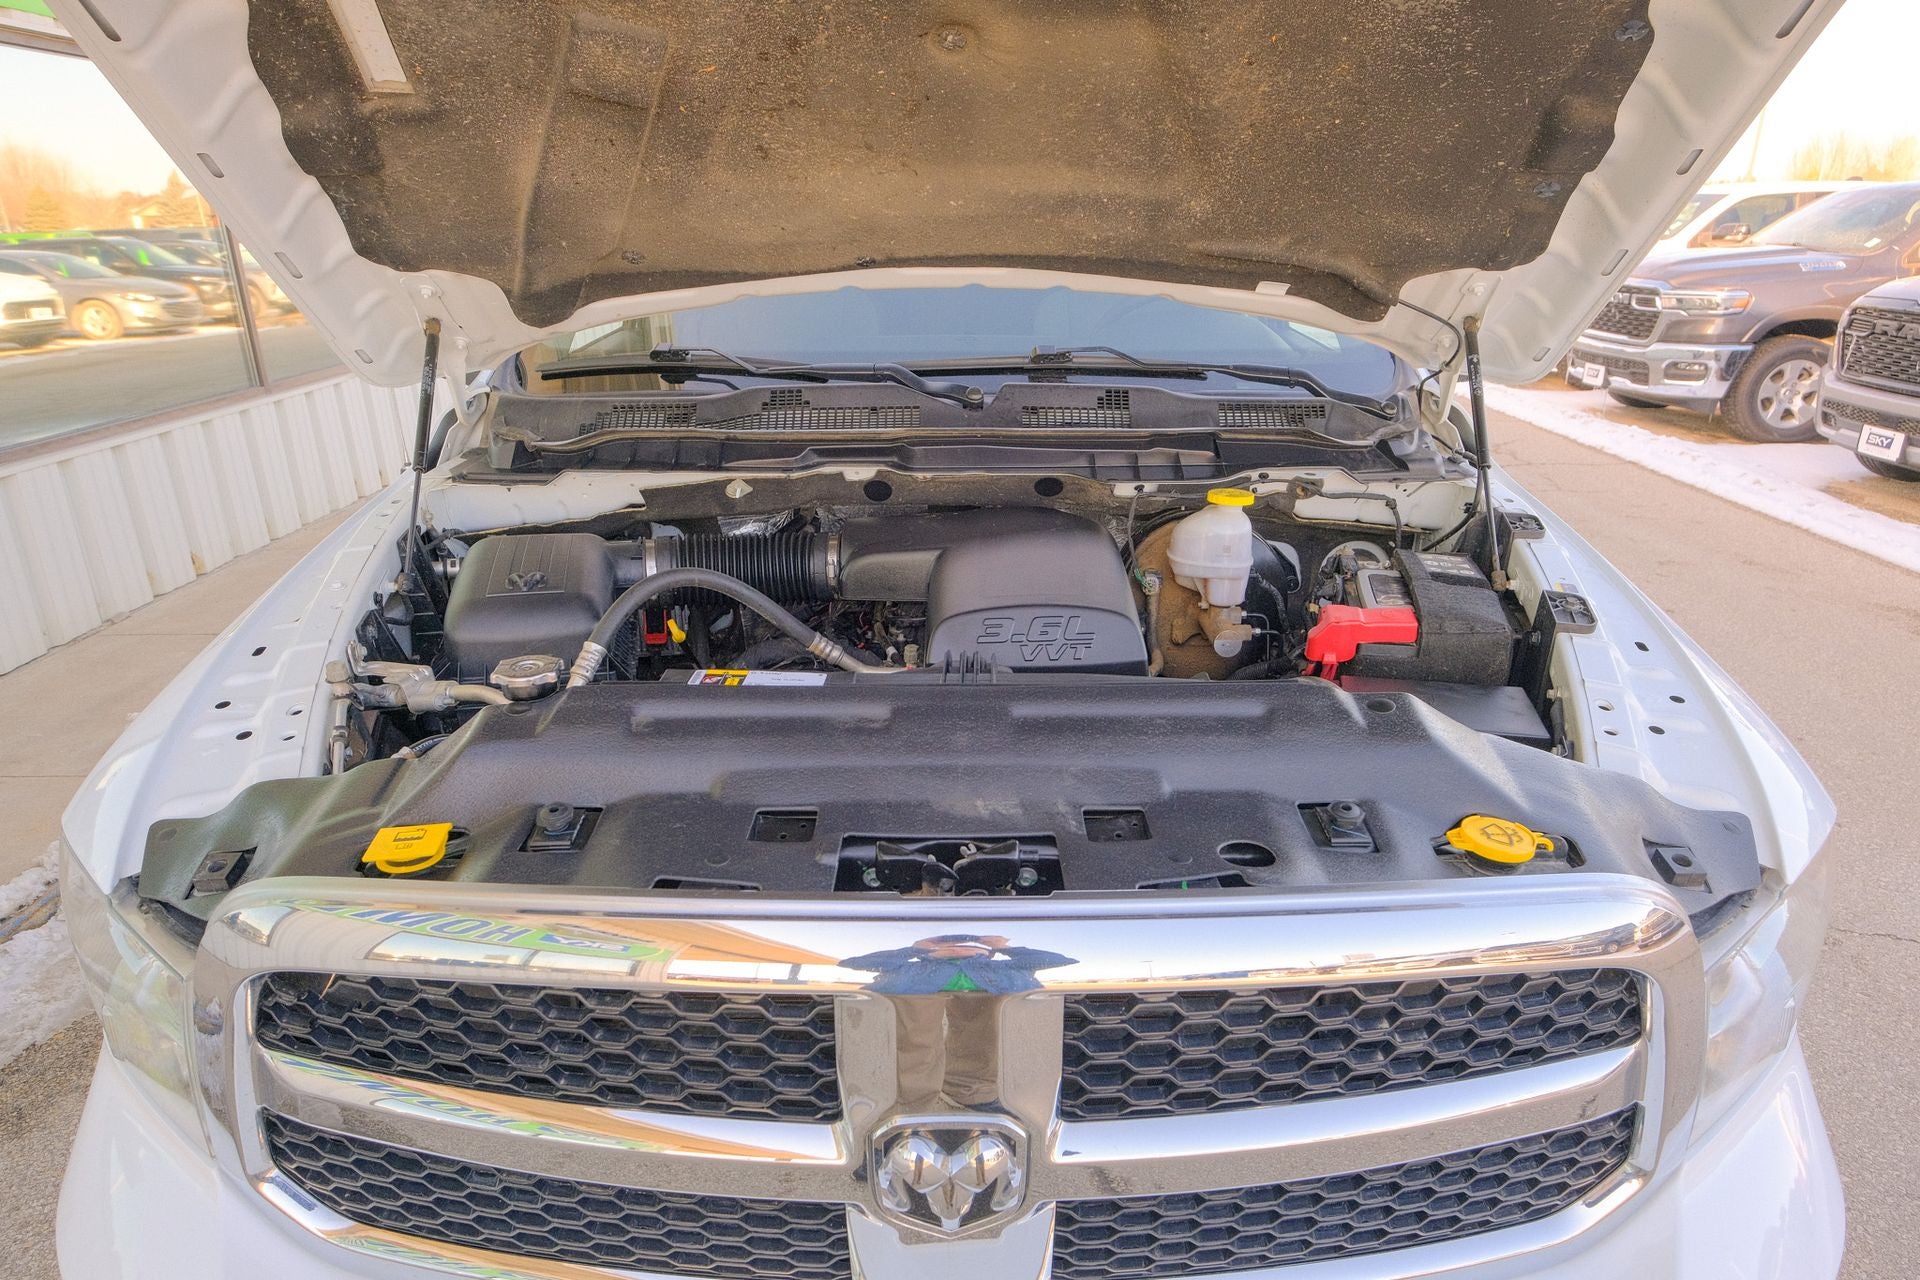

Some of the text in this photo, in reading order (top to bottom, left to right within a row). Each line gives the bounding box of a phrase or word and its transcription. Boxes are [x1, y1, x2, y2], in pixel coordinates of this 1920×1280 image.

[1867, 434, 1892, 447] SKY
[976, 616, 1096, 644] 3.6L
[1019, 643, 1093, 662] VVT
